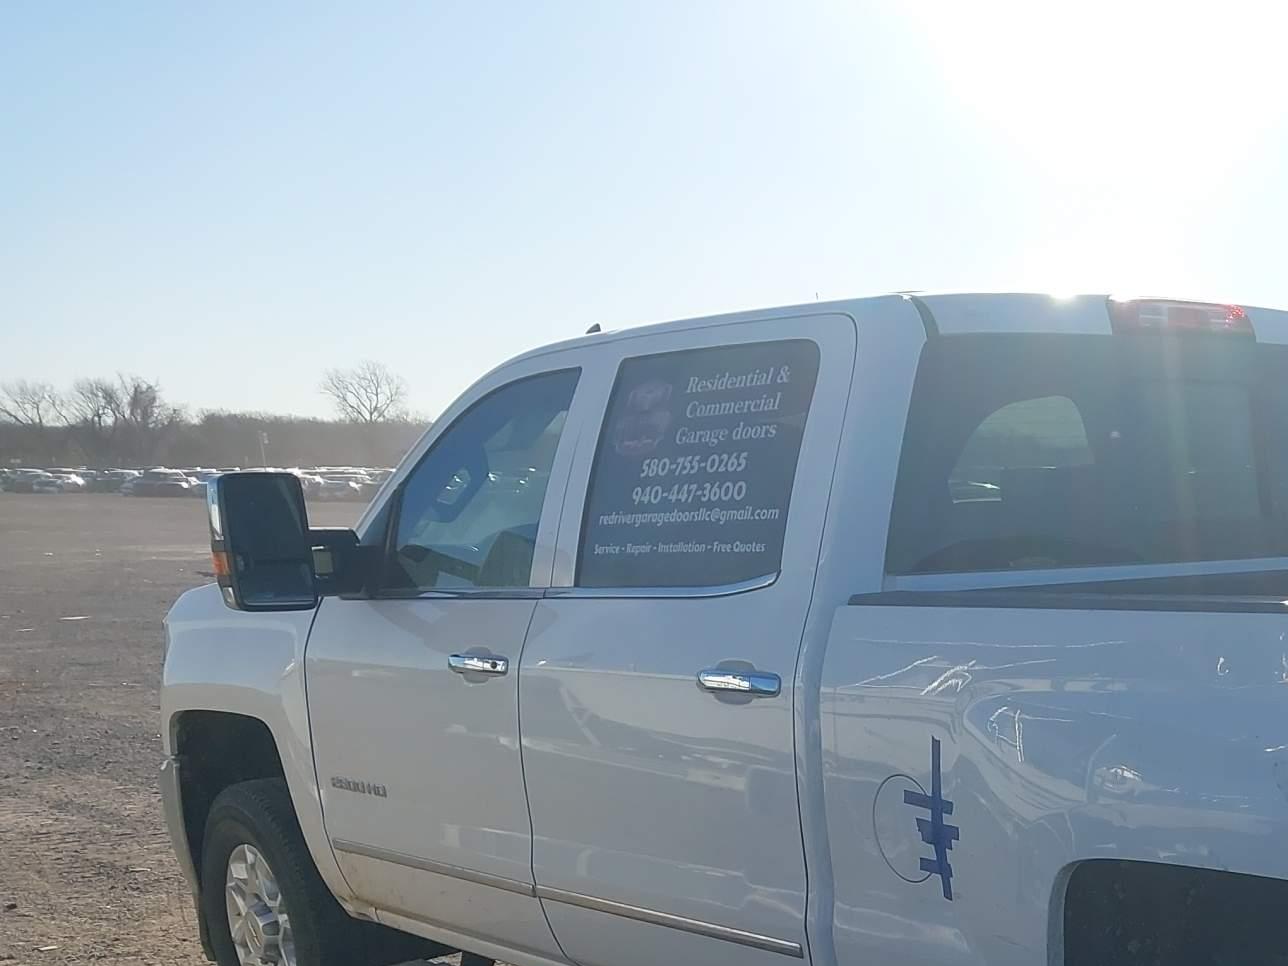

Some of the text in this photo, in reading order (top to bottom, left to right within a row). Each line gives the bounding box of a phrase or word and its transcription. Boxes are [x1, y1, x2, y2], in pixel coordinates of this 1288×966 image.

[686, 365, 791, 393] Residential &
[686, 393, 781, 418] Commercial
[675, 426, 729, 447] Garage
[731, 421, 778, 441] doors
[640, 452, 748, 478] 580-755-0265
[632, 481, 747, 505] 940-447-3600
[599, 507, 780, 526] redrivergaragedoorsllc@gmail.com
[594, 544, 620, 554] Service
[626, 543, 652, 555] Repair
[658, 540, 706, 552] Installation
[713, 540, 732, 552] Free
[734, 540, 766, 552] Quotes
